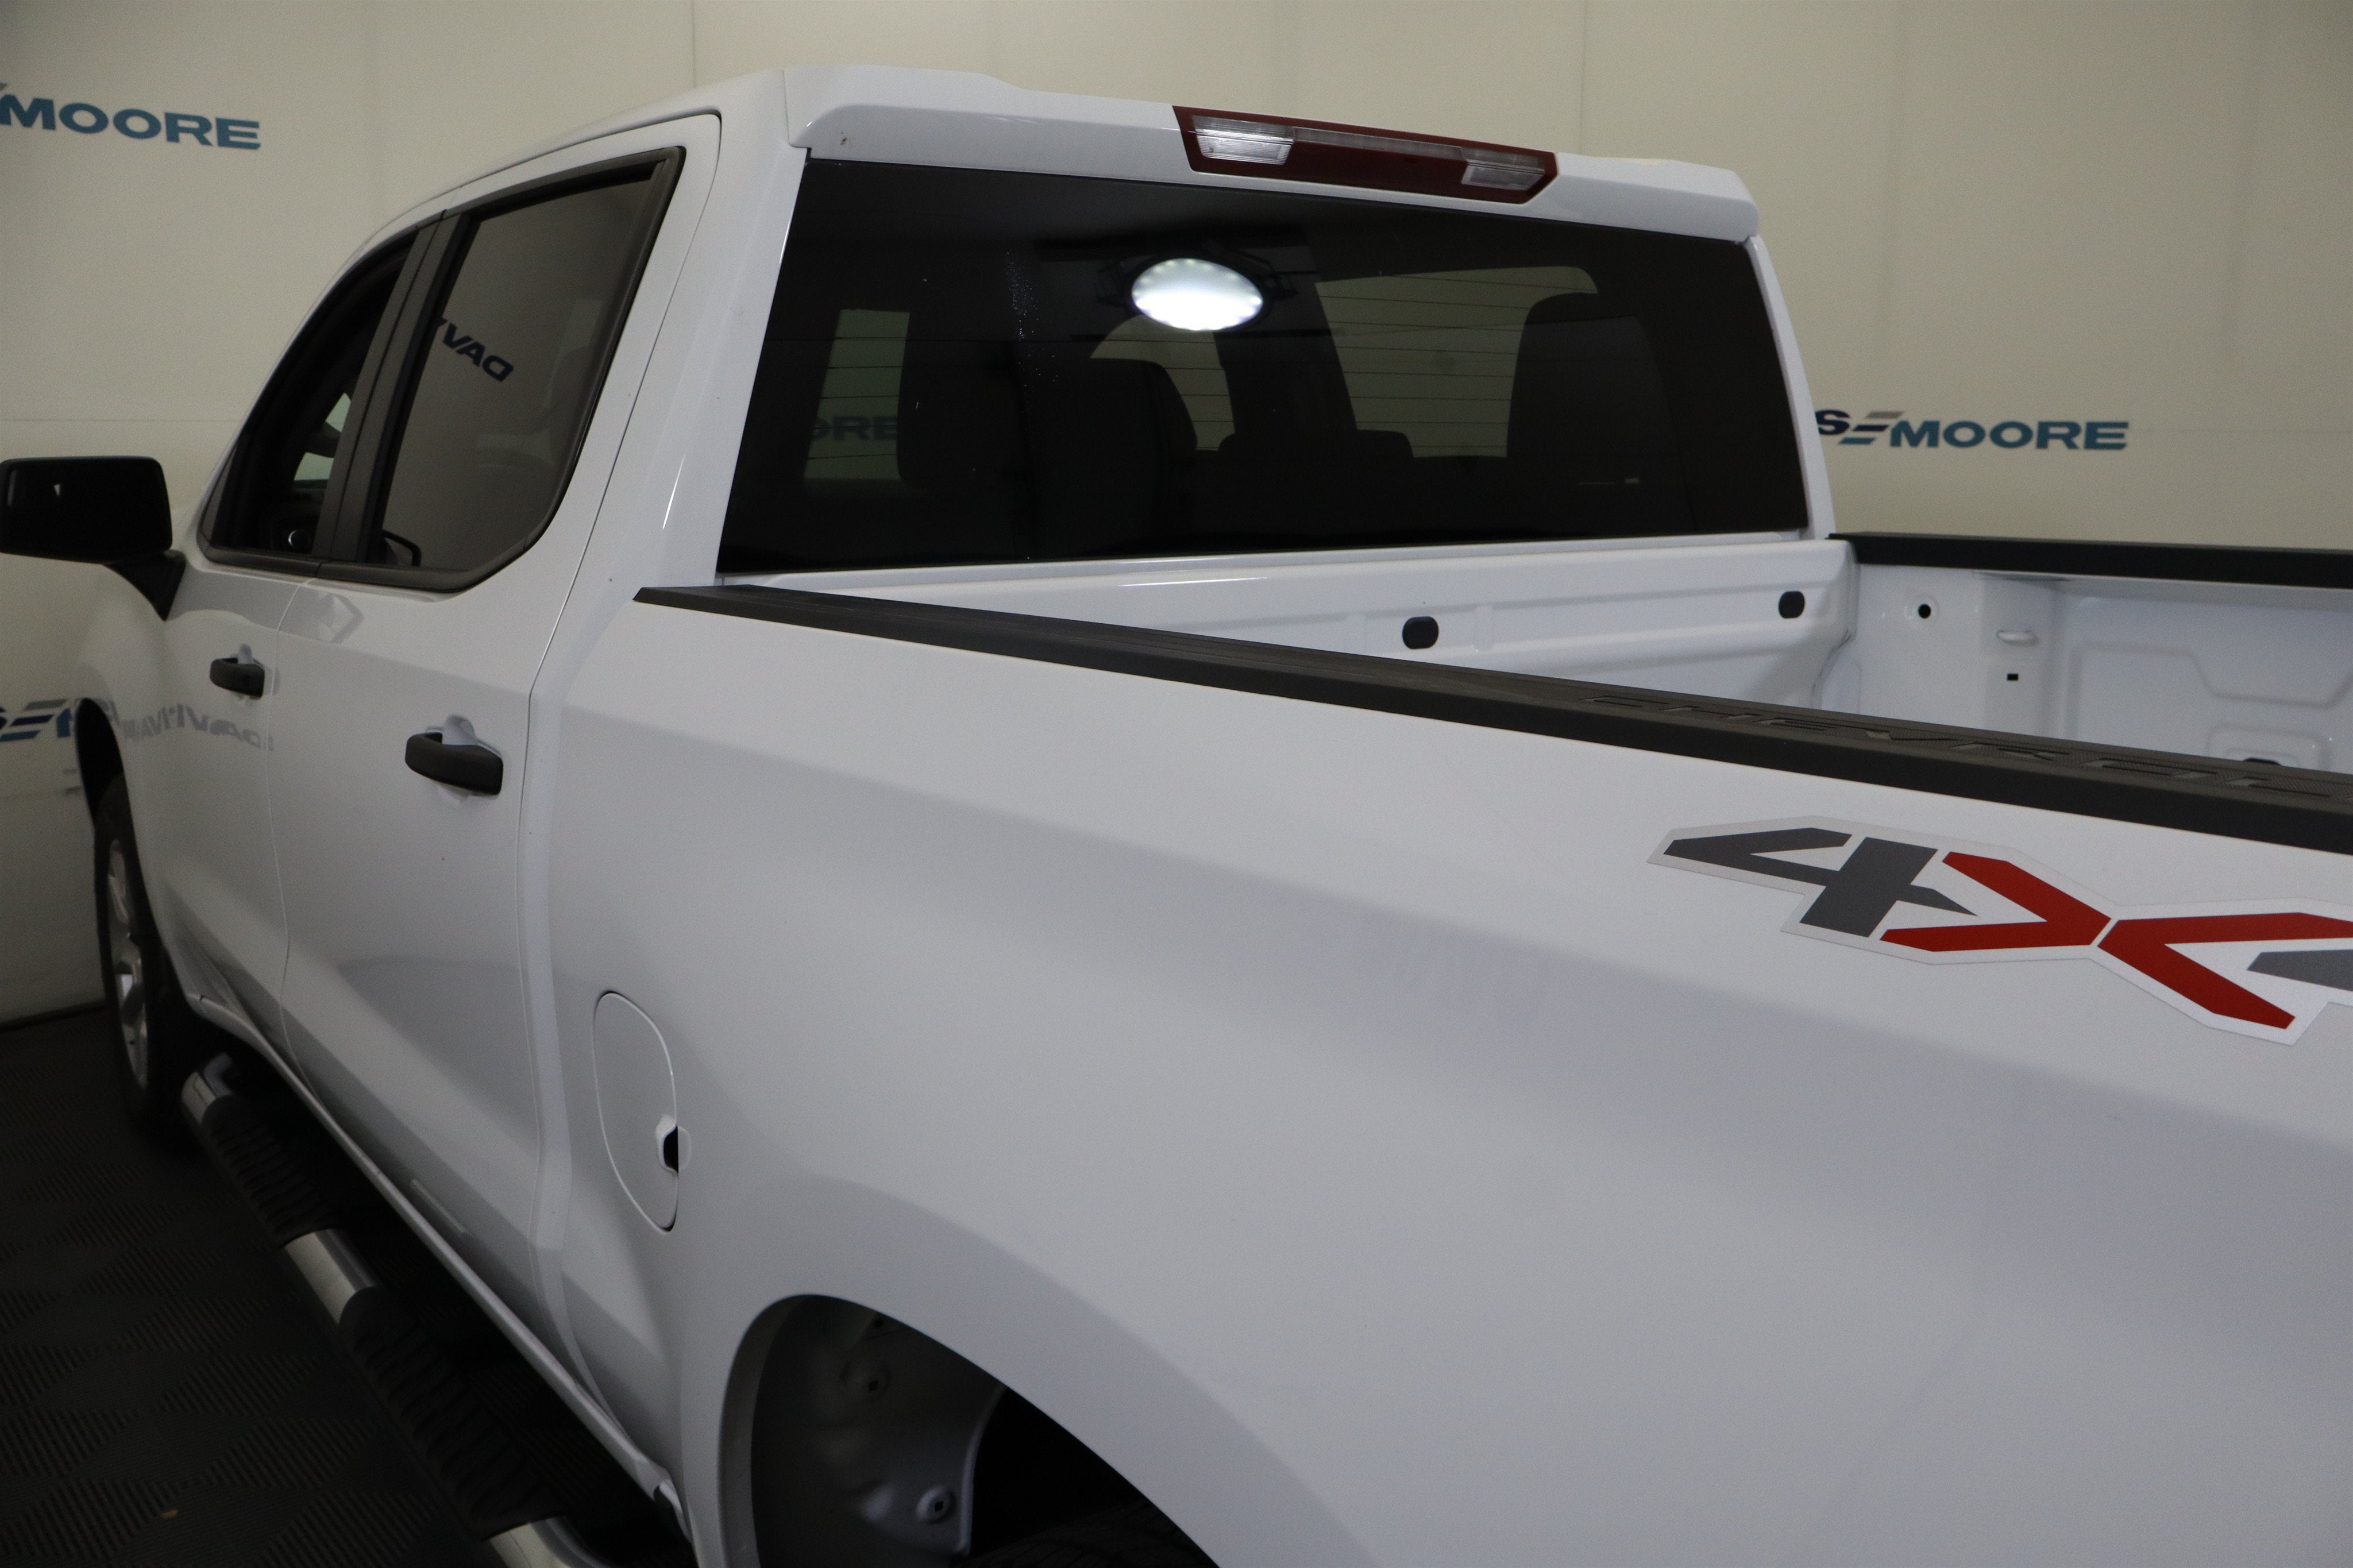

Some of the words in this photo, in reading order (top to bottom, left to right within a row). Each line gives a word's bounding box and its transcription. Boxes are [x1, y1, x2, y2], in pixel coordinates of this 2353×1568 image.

[0, 94, 261, 150] MOORE
[1889, 420, 2129, 450] MOORE
[1577, 694, 2353, 802] CHEVROL
